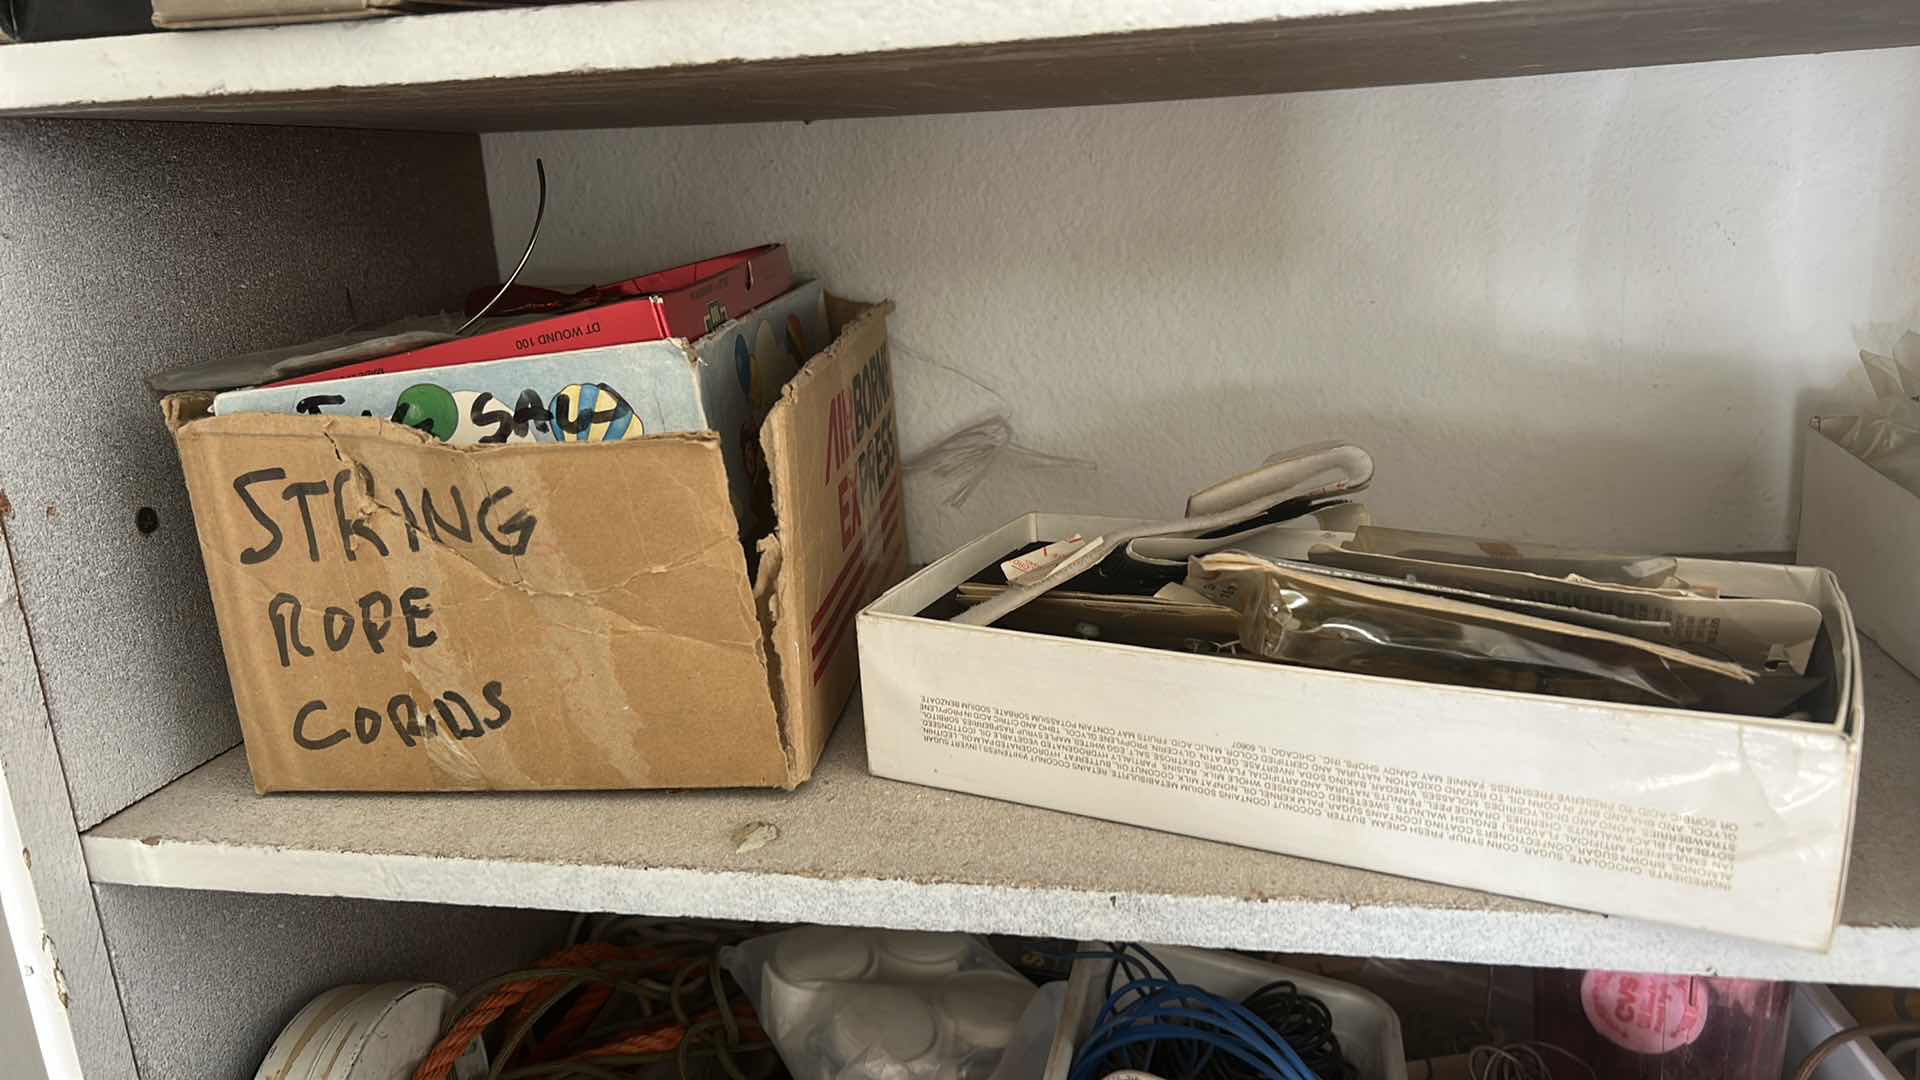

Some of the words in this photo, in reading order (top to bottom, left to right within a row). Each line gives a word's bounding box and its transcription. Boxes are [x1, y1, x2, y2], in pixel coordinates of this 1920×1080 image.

[538, 326, 583, 345] WOUND
[585, 321, 601, 335] DT
[515, 337, 535, 350] 100
[838, 408, 897, 553] EXPRESS
[233, 467, 538, 564] STRING
[268, 587, 438, 667] ROPE
[293, 681, 512, 750] CORDS
[919, 703, 963, 717] PROPYLENE
[960, 702, 990, 714] SODIUM
[973, 712, 992, 722] ACID
[993, 716, 1019, 727] CITRIC
[1031, 714, 1076, 729] POTASSIUM
[1077, 722, 1115, 735] CONTAIN
[950, 740, 976, 751] INVERT
[973, 736, 994, 746] PALM
[993, 732, 1039, 746] VEGETABLE
[1044, 733, 1071, 744] MAPLE
[1099, 734, 1147, 750] PROPYLENE
[1135, 732, 1167, 745] FRUITS
[994, 740, 1061, 759] HYDROGENATED
[1040, 740, 1109, 759] HYDROGENATED
[1194, 743, 1223, 754] MALIC
[1027, 754, 1070, 769] COCONUT
[1110, 753, 1156, 768] 1TIALLY
[1260, 754, 1309, 769] CERTIFIED
[1071, 762, 1108, 776] RETAINS
[1130, 765, 1174, 780] COCONUT
[1334, 766, 1381, 781] NATURAL
[1381, 765, 1418, 778] CANDY
[1200, 778, 1237, 792] NONFAT
[1228, 775, 1261, 787] WHOLE
[1248, 770, 1299, 785] ARTIFICIAL
[1328, 774, 1367, 788] BAKING
[1446, 776, 1485, 789] FANNIE
[1180, 783, 1216, 796] SODIUM
[1258, 789, 1296, 802] KERNEL
[1263, 781, 1325, 799] CONDENSED
[1323, 782, 1369, 797] NATURAL
[1443, 784, 1487, 799] RETARD
[1218, 790, 1270, 807] (CONTAINS
[1297, 796, 1324, 807] PALM
[1327, 792, 1390, 810] SWEETENED
[1527, 798, 1560, 812] CORN
[1273, 800, 1322, 816] COCONUT
[1455, 805, 1500, 820] ORANGE
[1365, 808, 1423, 825] (CONTAINS
[1450, 814, 1498, 829] ENGLISH
[1409, 825, 1443, 838] FRESH
[1424, 818, 1473, 834] COATING
[1599, 820, 1635, 834] MONO
[1487, 839, 1519, 852] CORN
[1564, 834, 1626, 852] ARTIFICIAL
[1620, 853, 1666, 869] BROWN
